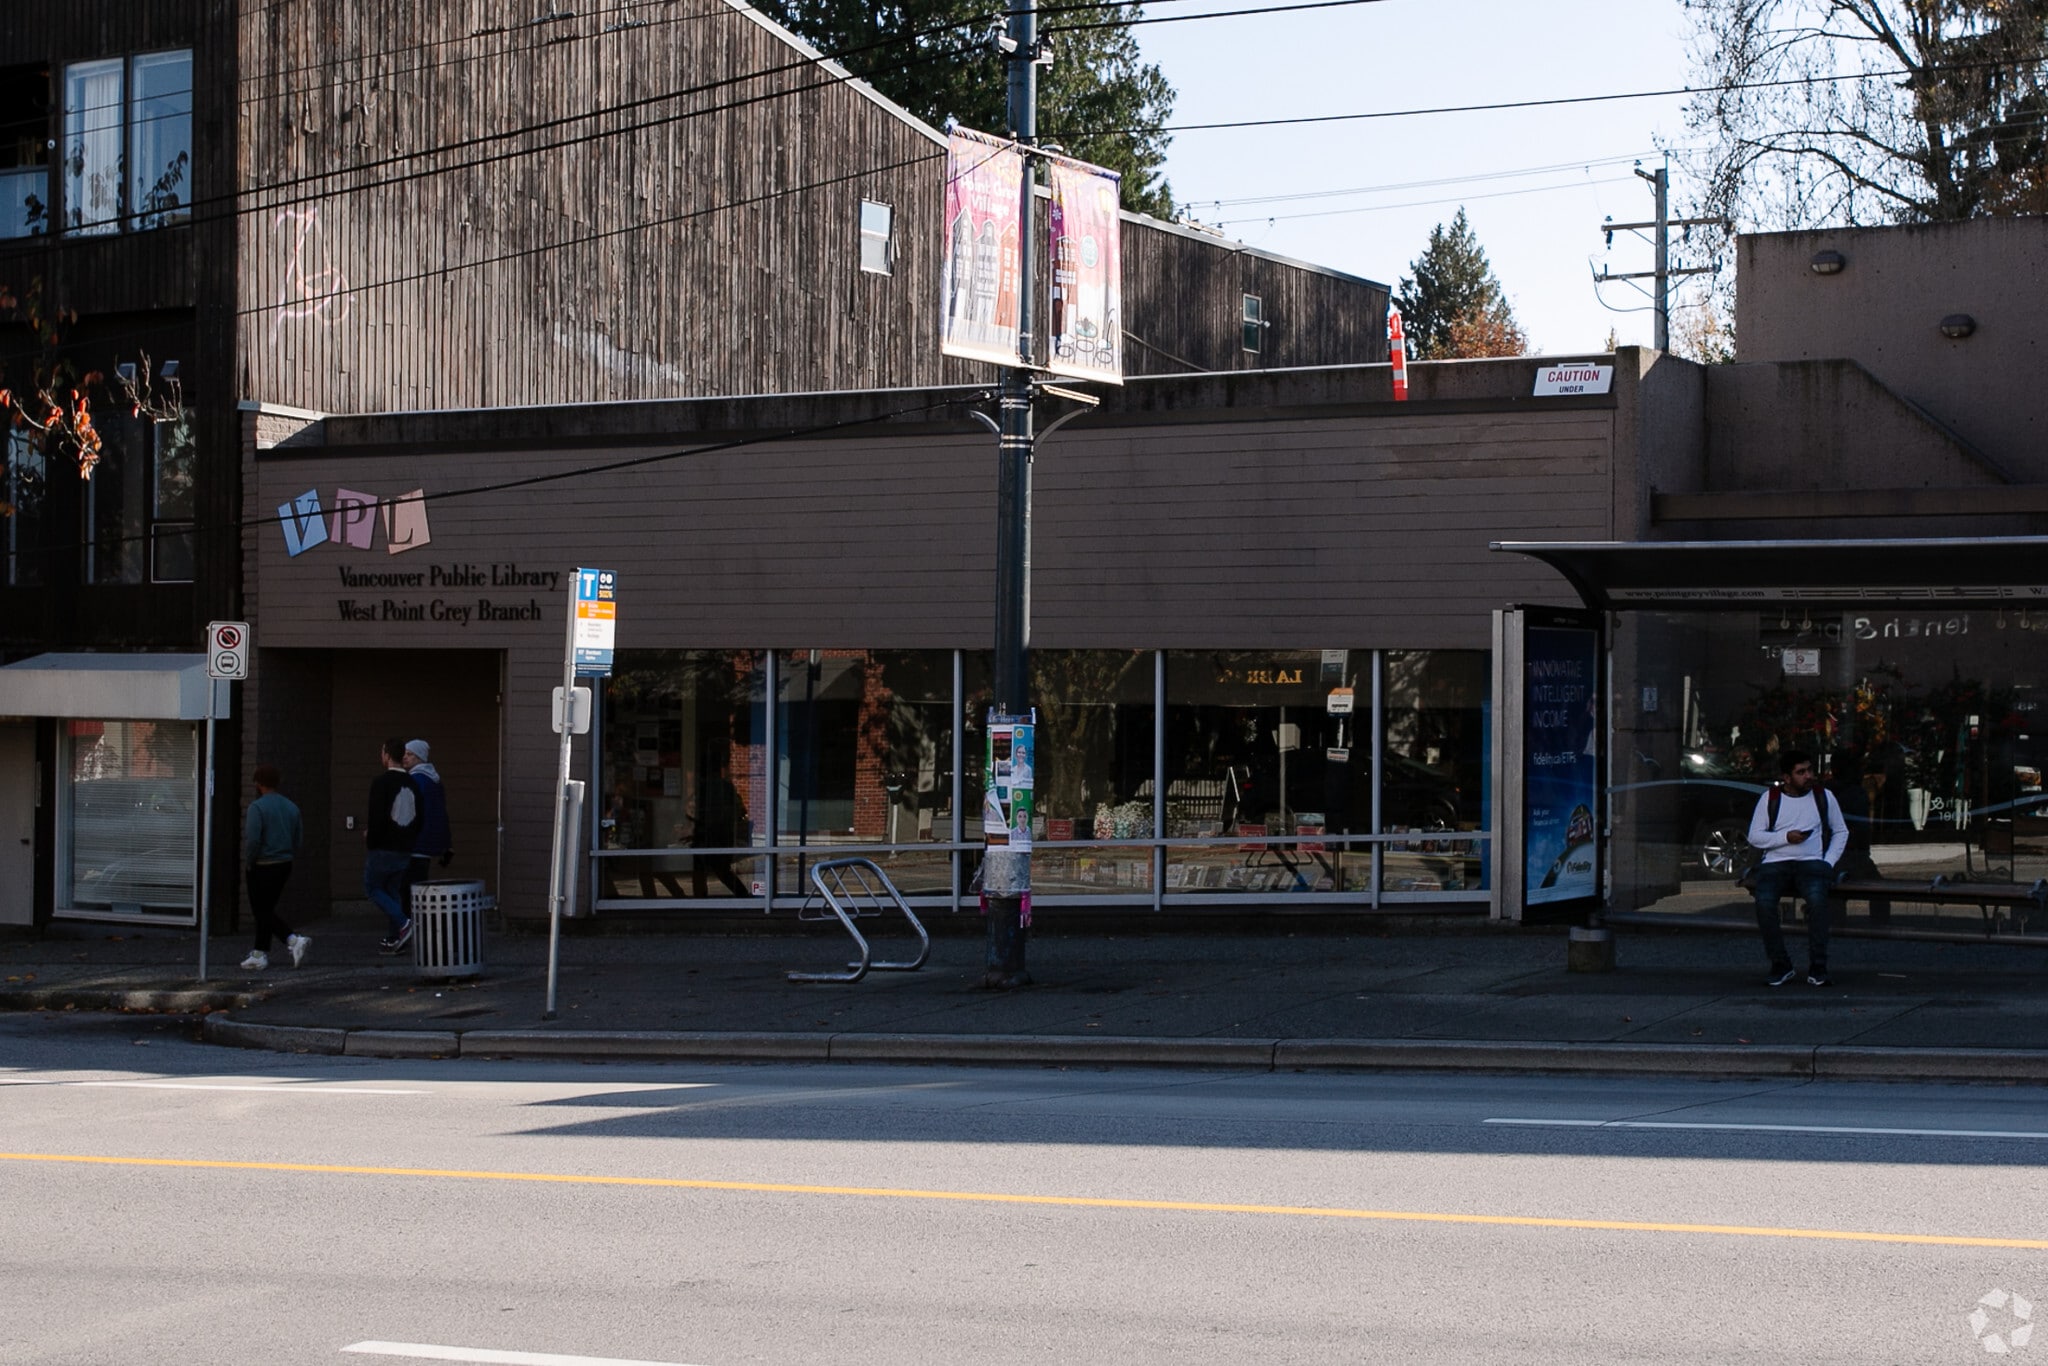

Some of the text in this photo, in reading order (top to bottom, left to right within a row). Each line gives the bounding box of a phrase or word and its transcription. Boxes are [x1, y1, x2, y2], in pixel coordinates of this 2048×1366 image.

[960, 174, 991, 195] Point
[972, 192, 1010, 219] Village
[1547, 369, 1601, 382] CAUTION
[1559, 385, 1584, 393] UNDER
[281, 492, 427, 553] VPL
[338, 563, 559, 592] Vancouver Public Library
[583, 573, 596, 597] T
[1625, 589, 1766, 600] www.pointgreyvillage.com
[338, 598, 541, 627] West Point Grey Branch
[1533, 684, 1585, 703] INTELLIGENT
[1533, 709, 1569, 729] INCOME
